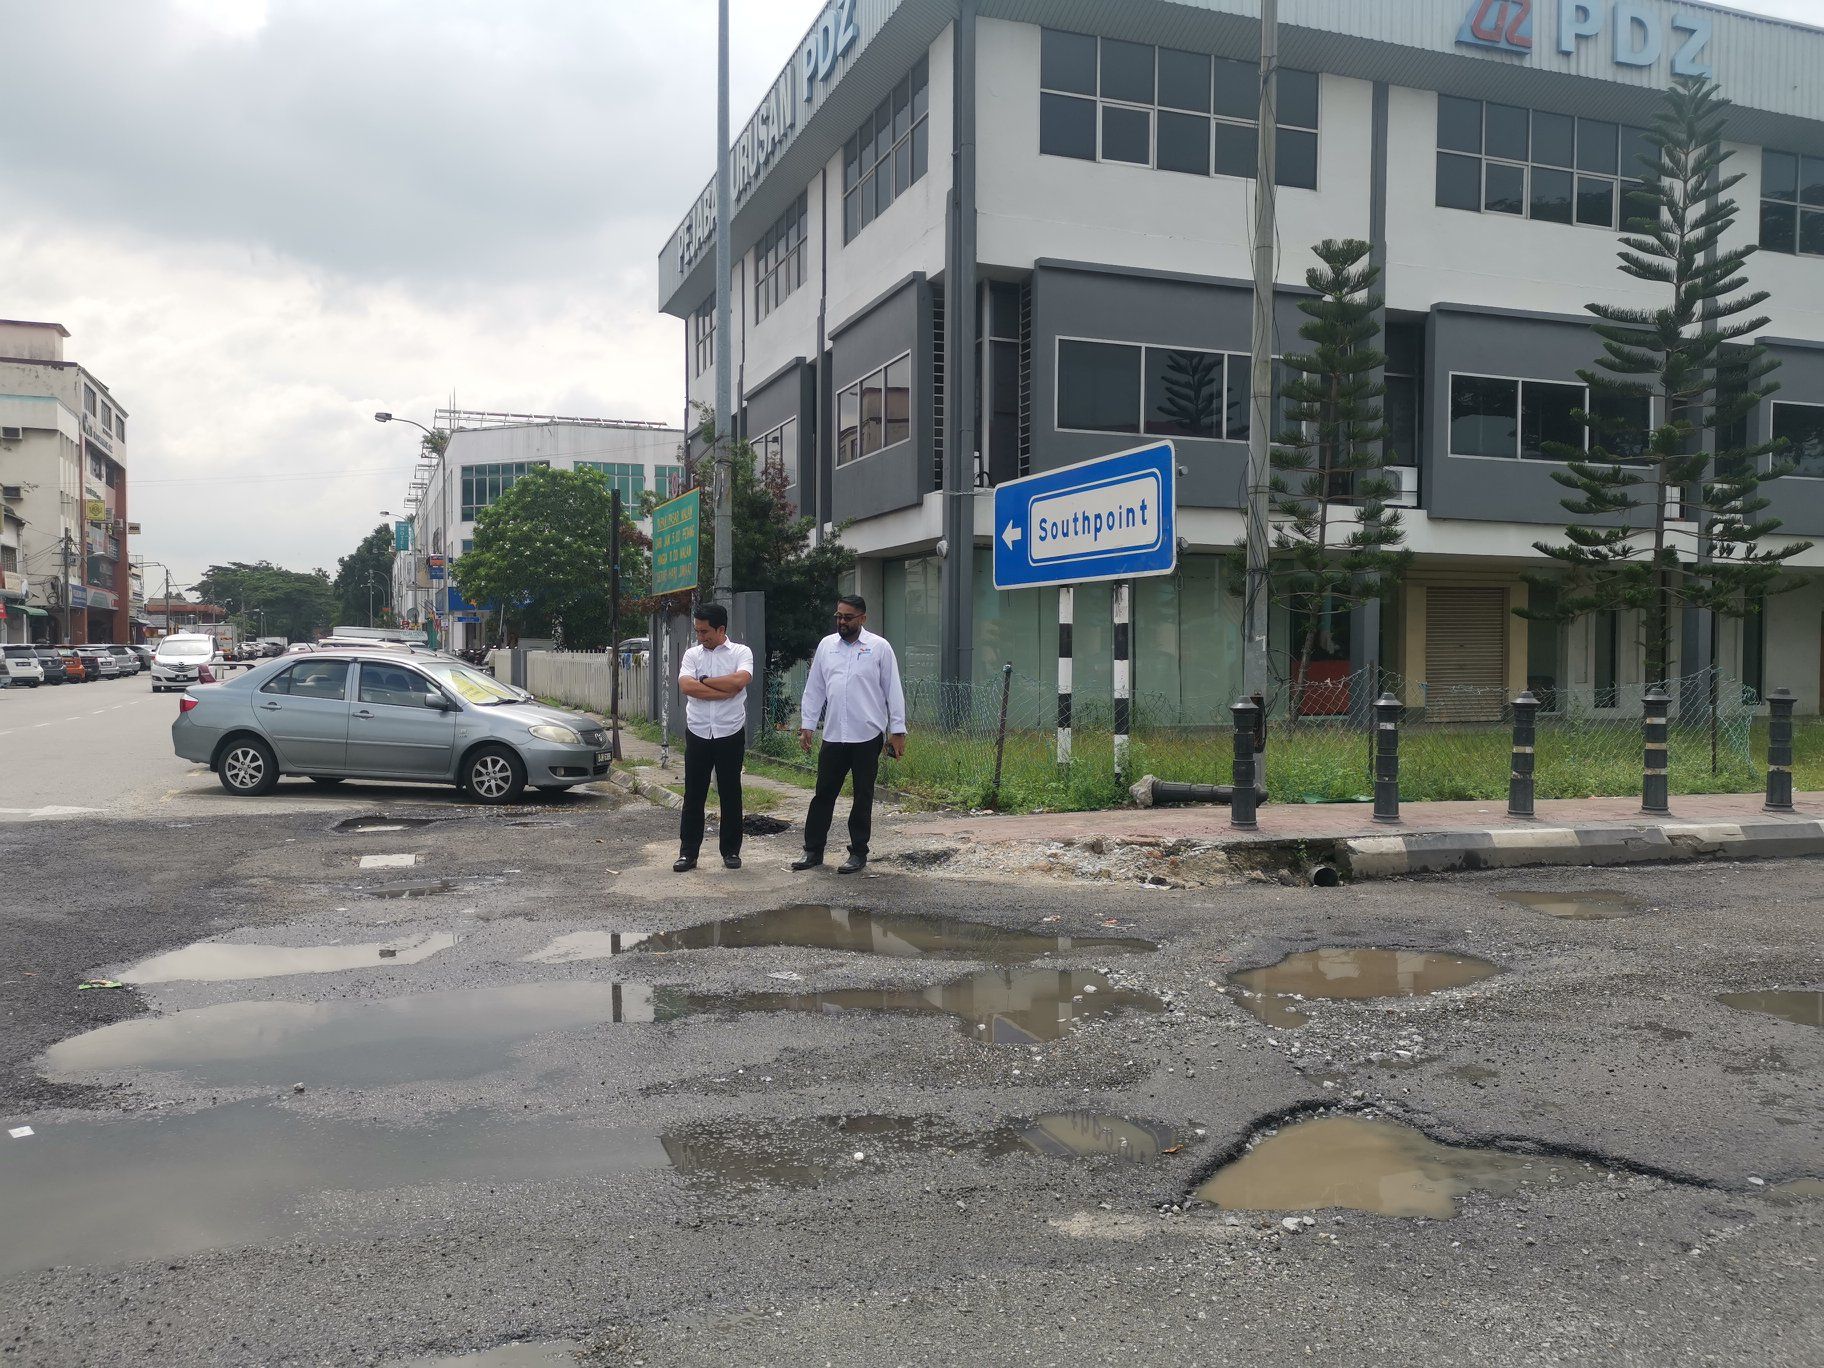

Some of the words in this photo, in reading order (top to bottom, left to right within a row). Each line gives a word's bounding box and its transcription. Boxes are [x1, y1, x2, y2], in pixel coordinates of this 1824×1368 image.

[1558, 0, 1713, 79] PDZ
[678, 174, 720, 272] PEJABA
[729, 62, 794, 201] URUSAN
[802, 0, 857, 102] PDZ
[1038, 498, 1148, 541] Southpoint
